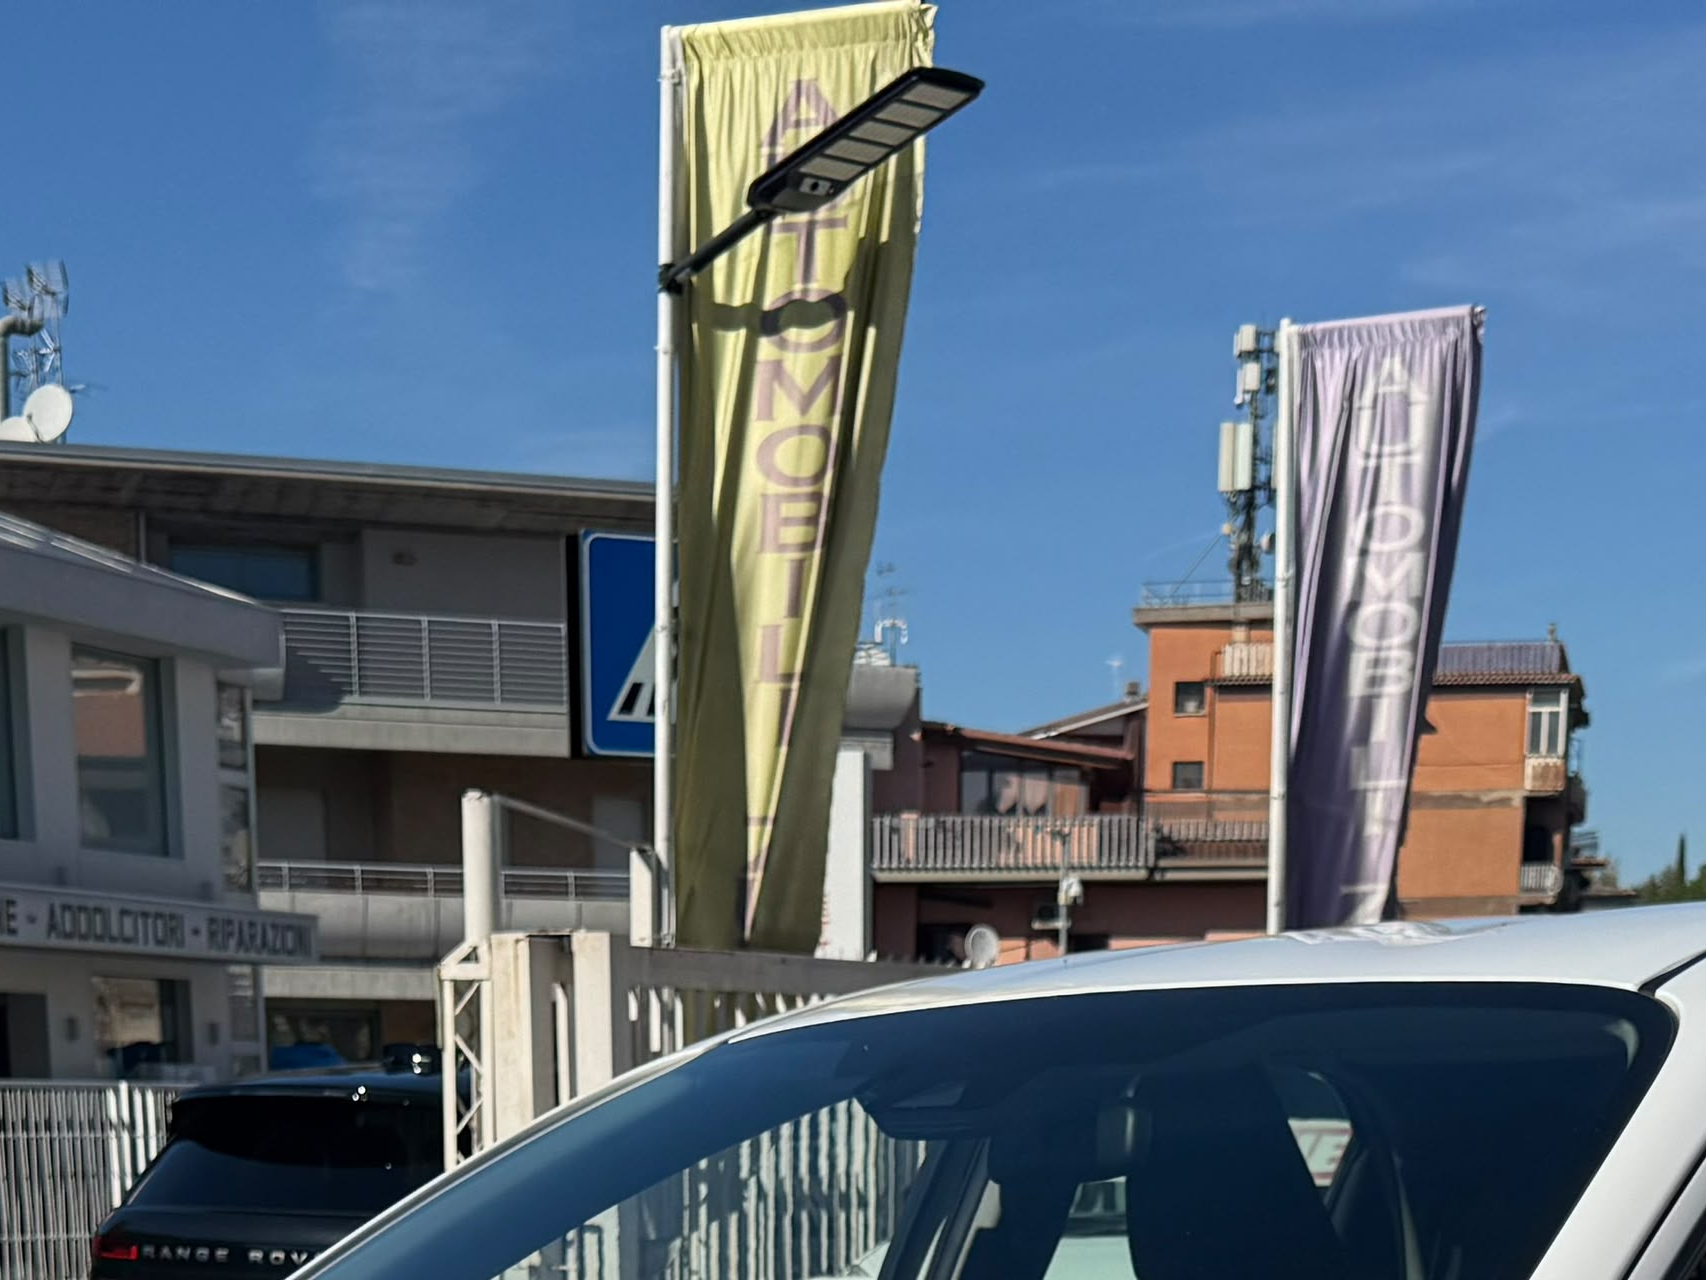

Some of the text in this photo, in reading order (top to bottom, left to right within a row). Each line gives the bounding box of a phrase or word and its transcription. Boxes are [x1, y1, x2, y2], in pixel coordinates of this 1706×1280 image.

[755, 78, 849, 748] ATOMOBILI
[46, 902, 186, 949] ADDOLCITORI
[206, 916, 313, 957] RIPARAZIONI
[144, 1245, 319, 1266] RANGE ROV
